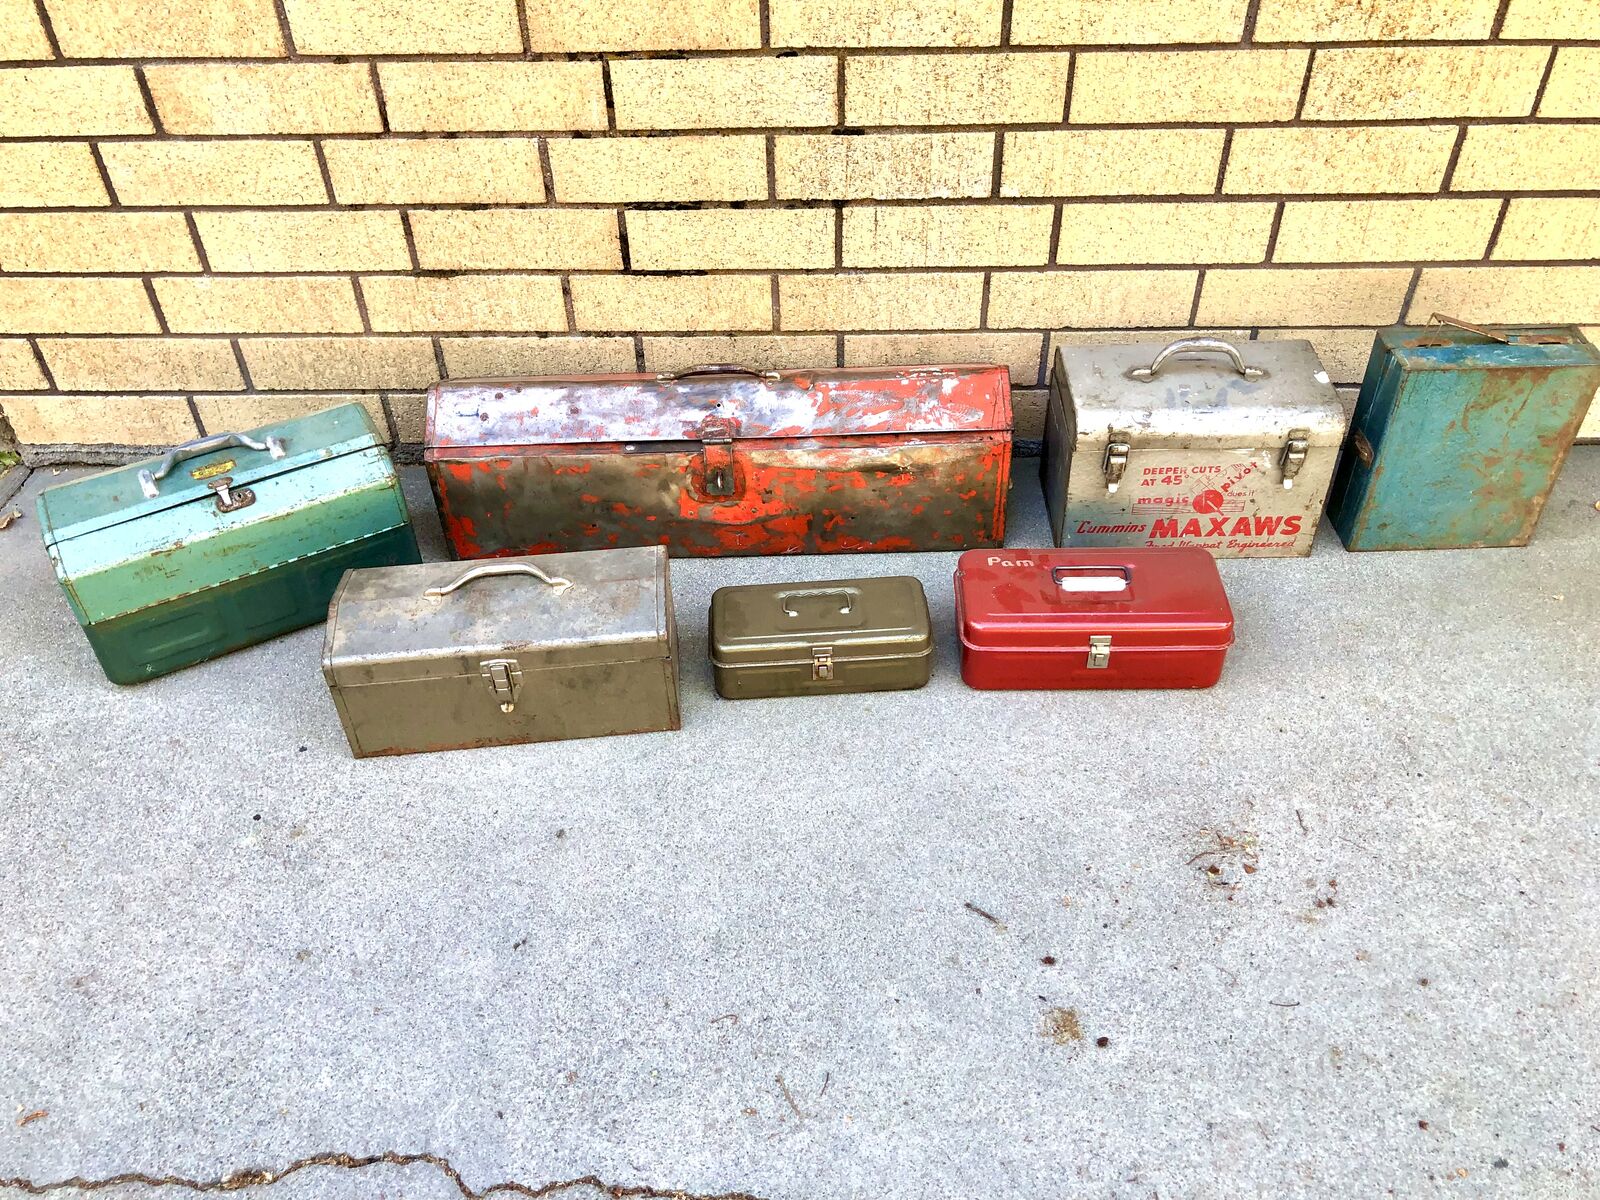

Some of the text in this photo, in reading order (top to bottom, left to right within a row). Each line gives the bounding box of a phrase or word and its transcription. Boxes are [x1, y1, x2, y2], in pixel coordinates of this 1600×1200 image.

[1142, 465, 1221, 475] DEEPER CUTS
[1221, 461, 1257, 492] pivot
[1141, 478, 1157, 486] AT
[1076, 516, 1302, 538] Cummins MAXAWS
[1226, 537, 1296, 553] Engineered
[987, 556, 1034, 567] Pam
